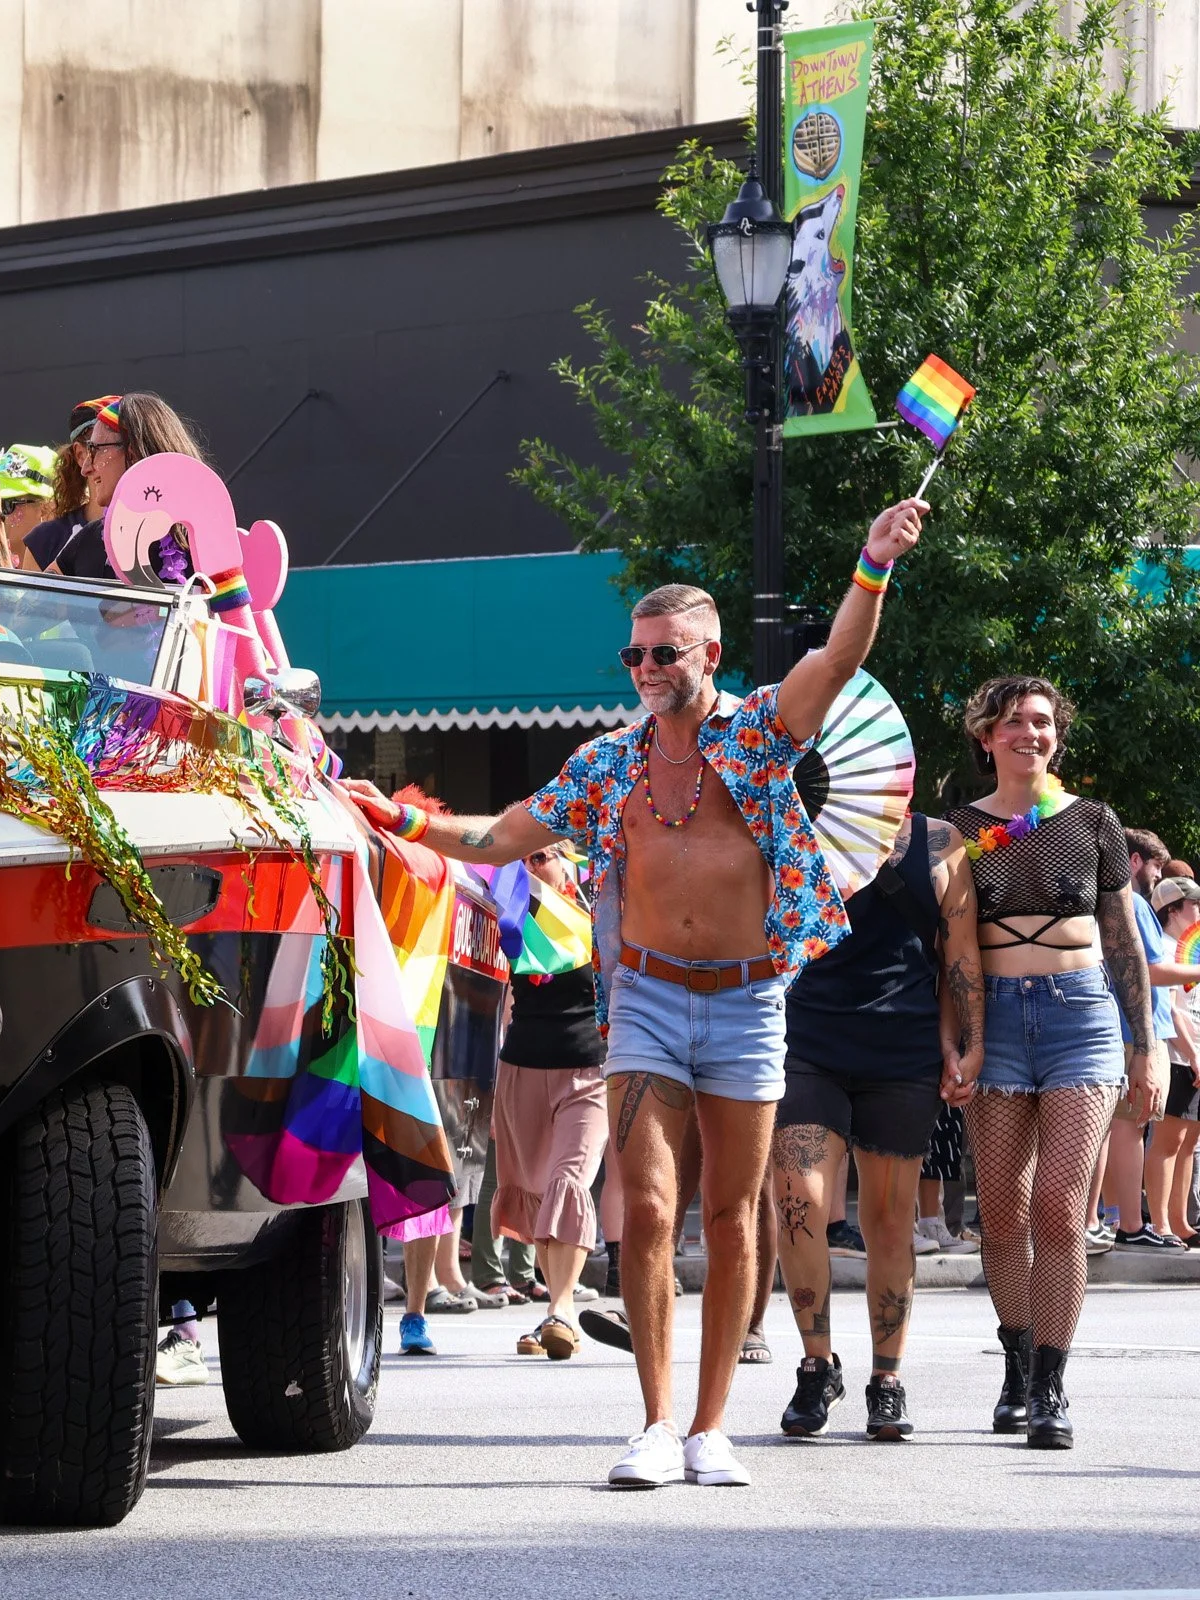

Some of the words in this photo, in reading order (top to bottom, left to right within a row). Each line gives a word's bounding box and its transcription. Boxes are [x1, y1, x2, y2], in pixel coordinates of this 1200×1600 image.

[800, 68, 859, 107] ATHENS
[816, 345, 846, 405] ENDLESS
[829, 351, 853, 403] PARTY
